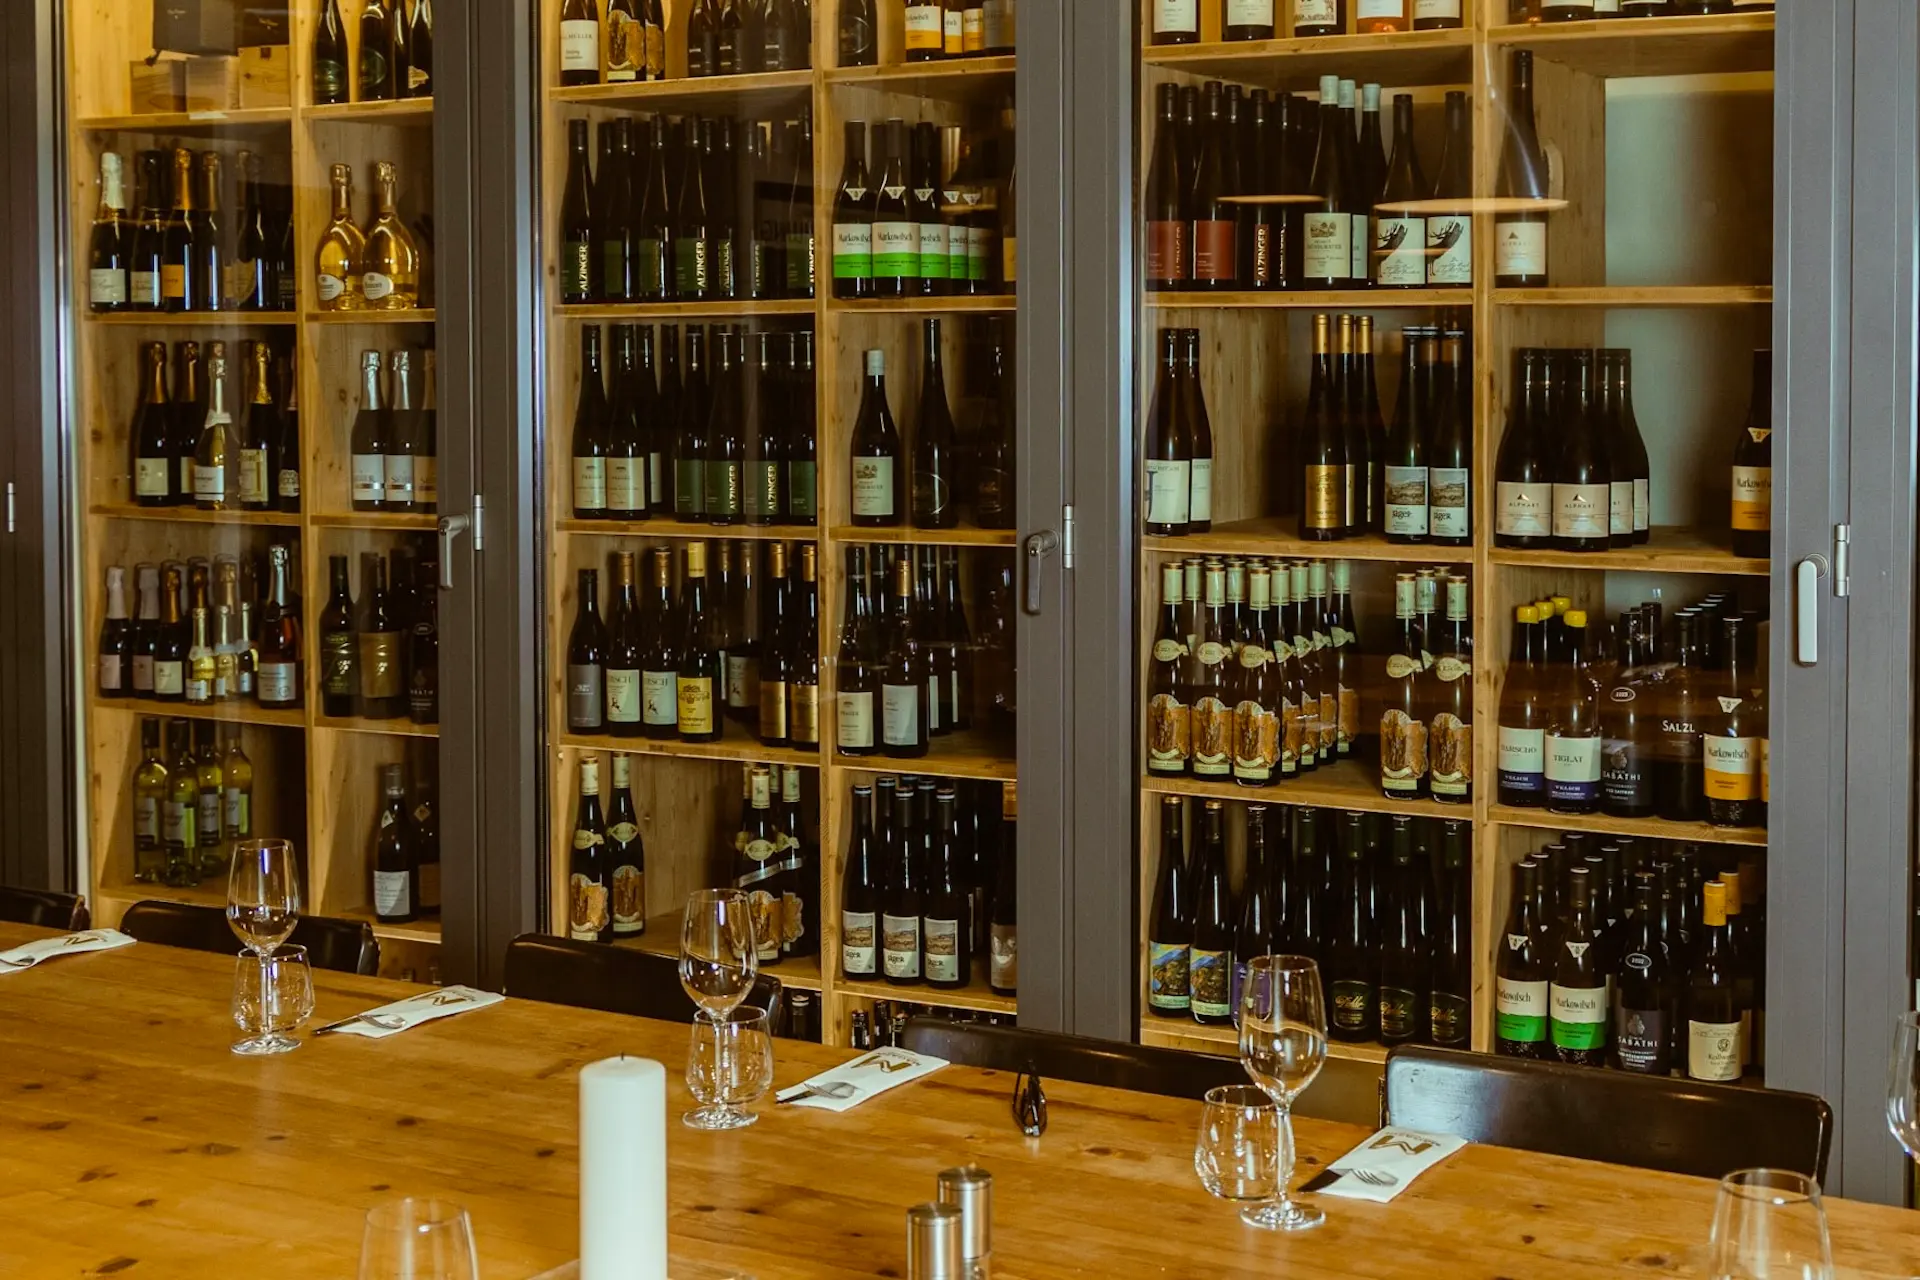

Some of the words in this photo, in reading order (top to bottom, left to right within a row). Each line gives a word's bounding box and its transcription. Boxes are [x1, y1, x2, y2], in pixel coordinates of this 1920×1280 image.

[1257, 228, 1267, 277] ALZINGER
[578, 244, 589, 291] ALZINGER
[695, 240, 706, 288] ALZINGER
[1662, 719, 1696, 733] SALZL
[1553, 752, 1584, 764] TIGLAT
[1707, 746, 1750, 760] Markowitsch
[1555, 995, 1596, 1010] Markowitsch
[1618, 1035, 1658, 1048] SABATHI
